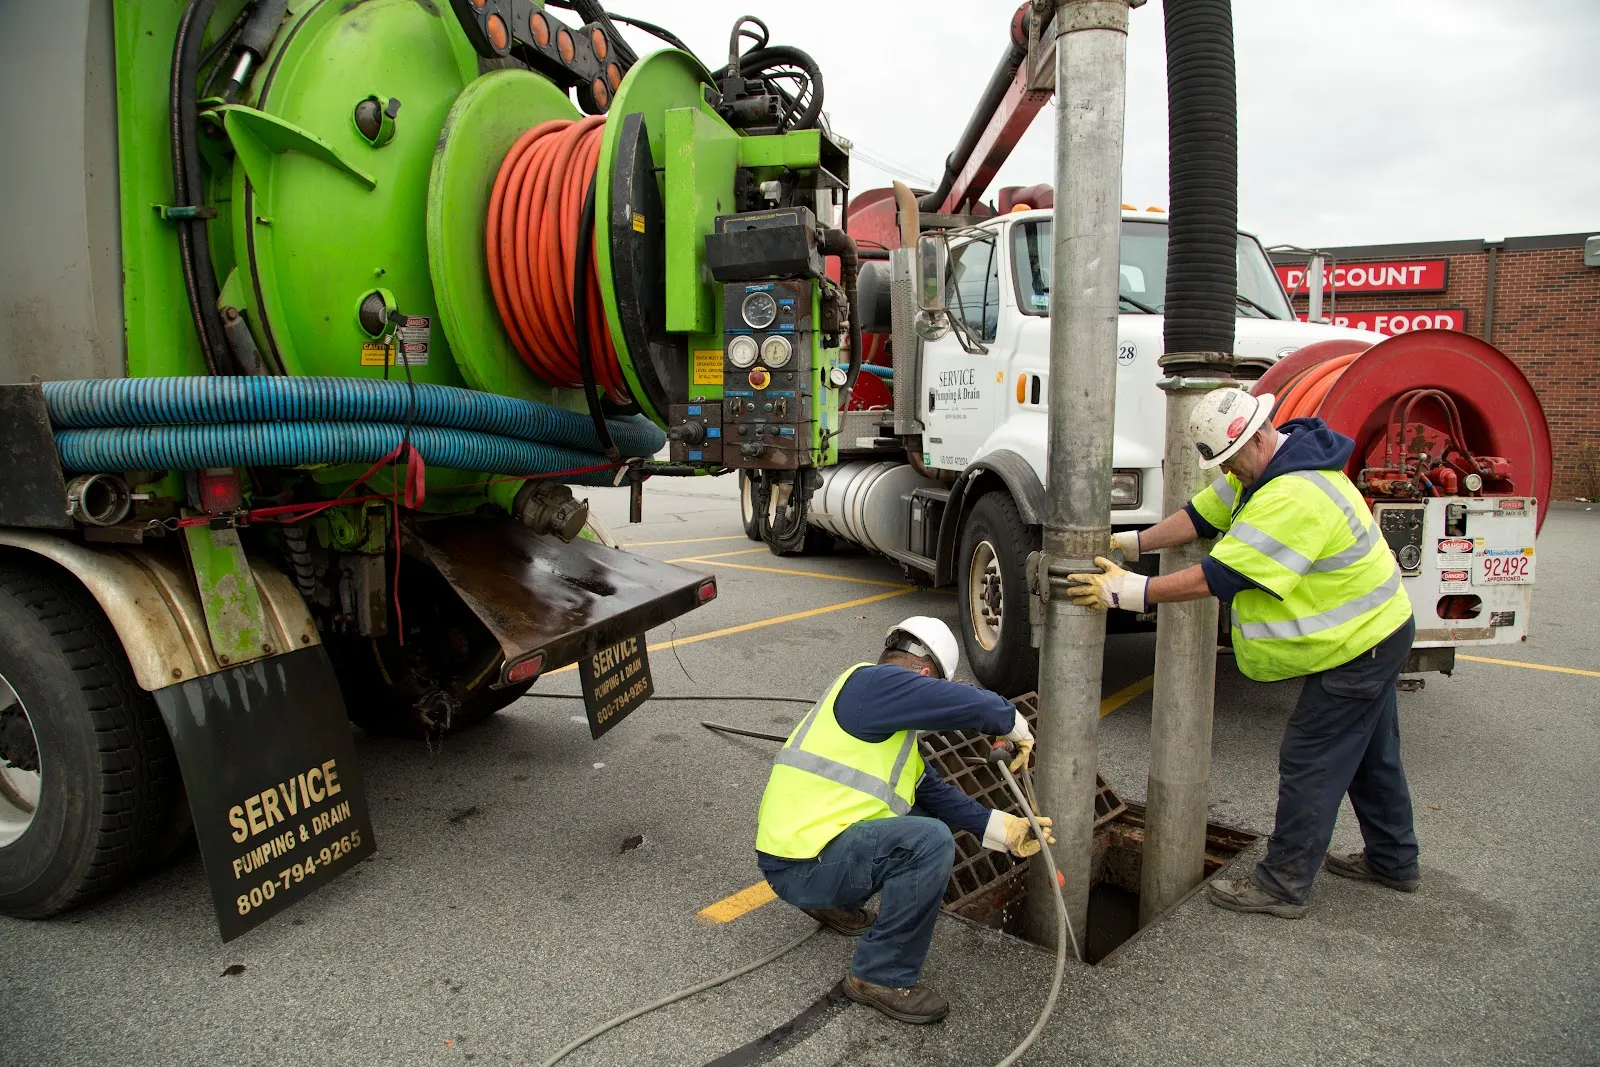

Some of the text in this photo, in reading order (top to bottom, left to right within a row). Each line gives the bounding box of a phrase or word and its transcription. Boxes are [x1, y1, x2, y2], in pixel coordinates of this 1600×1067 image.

[1374, 315, 1454, 335] FOOD
[1118, 346, 1135, 359] 28
[939, 368, 976, 387] SERVICE
[963, 387, 981, 400] Drain
[1484, 557, 1528, 576] 92492
[592, 637, 638, 679] SERVICE
[594, 657, 642, 701] PUMPING & DRAIN
[597, 676, 648, 724] 800-794-9265
[228, 758, 341, 844] SERVICE
[232, 800, 351, 879] PUMPING & DRAIN
[236, 829, 361, 915] 800-794-9265
